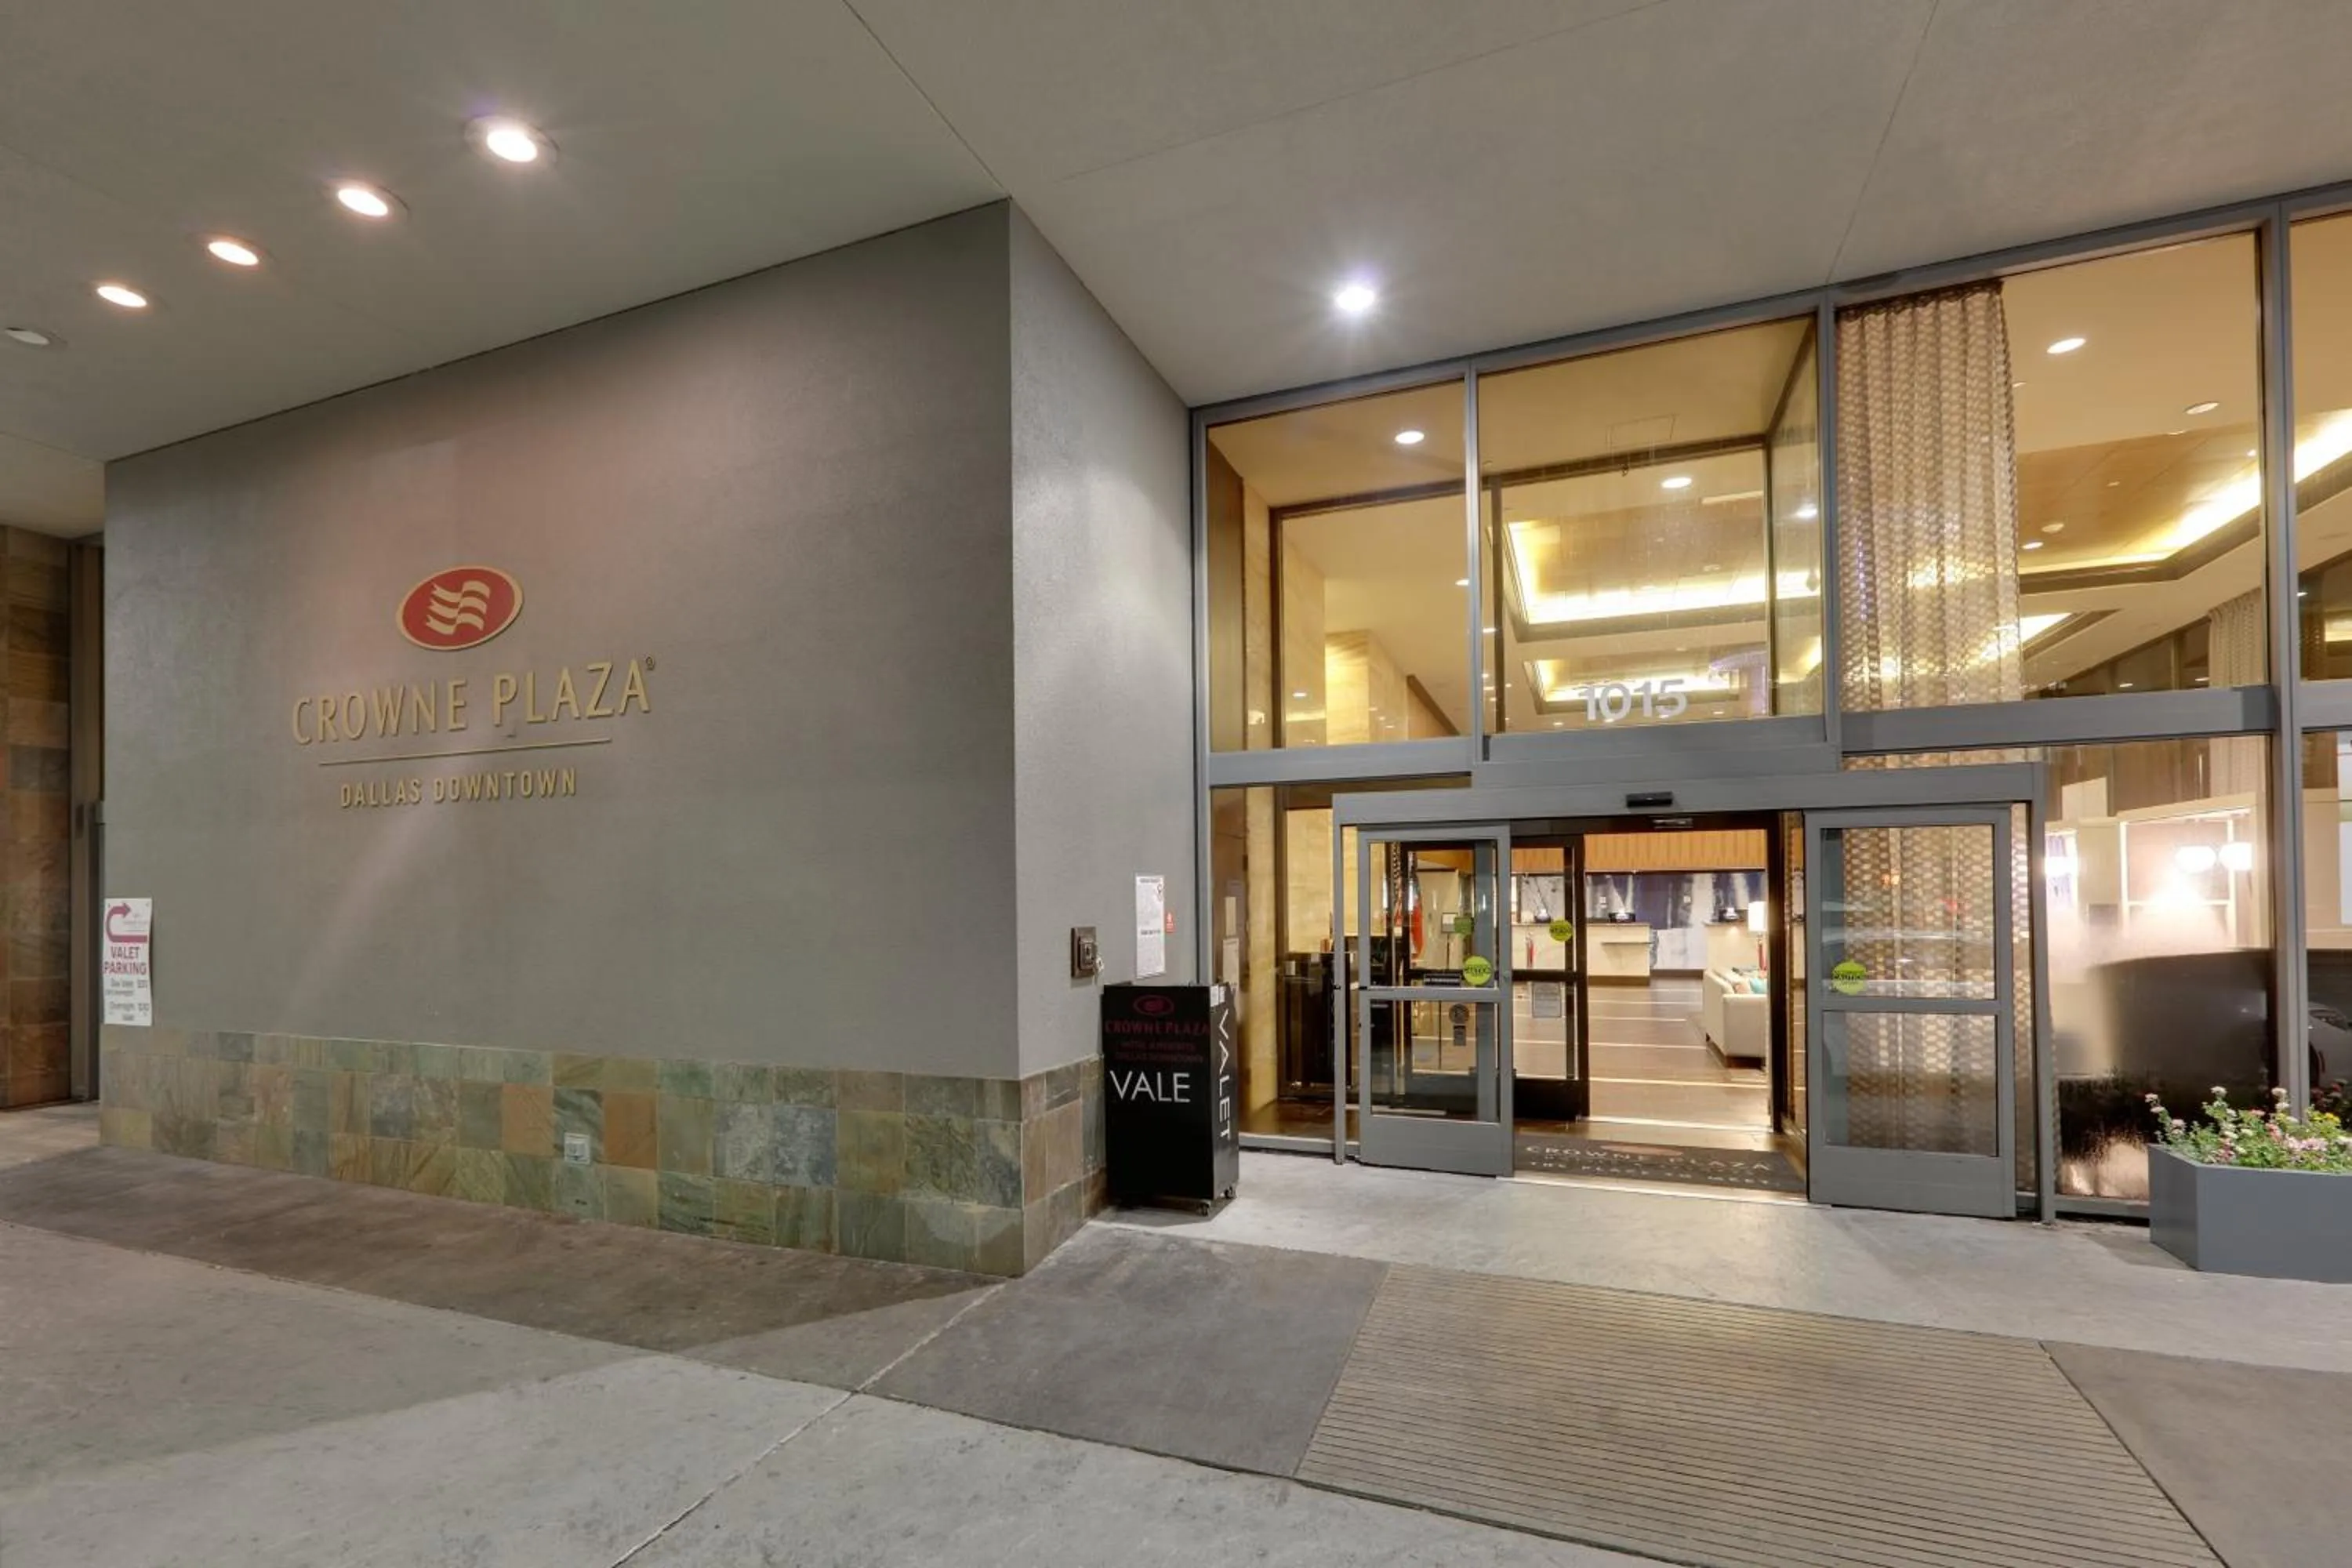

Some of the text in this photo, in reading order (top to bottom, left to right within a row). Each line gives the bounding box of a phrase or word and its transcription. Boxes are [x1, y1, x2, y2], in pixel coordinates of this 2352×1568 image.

[292, 675, 468, 746] CROWNE
[1578, 679, 1687, 720] 1015
[340, 767, 577, 808] DALLAS DOWNTOWN
[104, 961, 147, 975] PARKING
[111, 946, 140, 958] VALET
[1105, 1020, 1162, 1034] CROWNE
[1109, 1069, 1191, 1103] VALE
[1218, 1008, 1231, 1140] VALET
